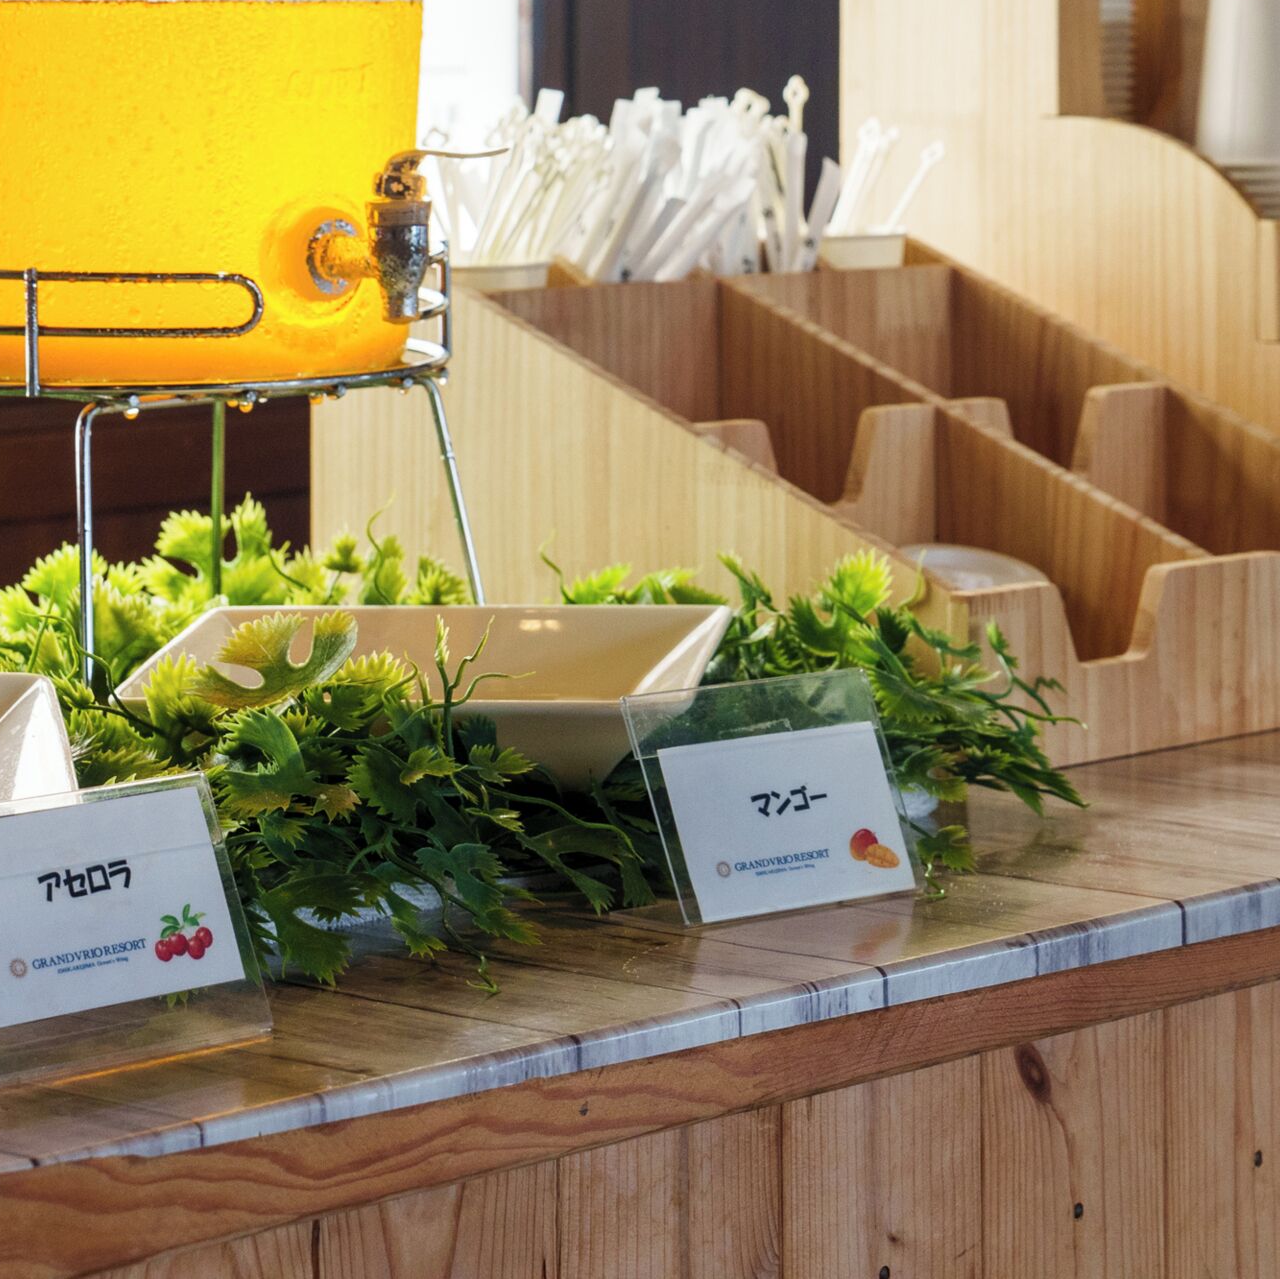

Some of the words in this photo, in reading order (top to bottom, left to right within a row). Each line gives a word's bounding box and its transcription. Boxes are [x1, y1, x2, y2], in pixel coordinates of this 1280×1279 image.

[750, 785, 828, 818] マンゴー
[37, 859, 132, 902] アセロラ
